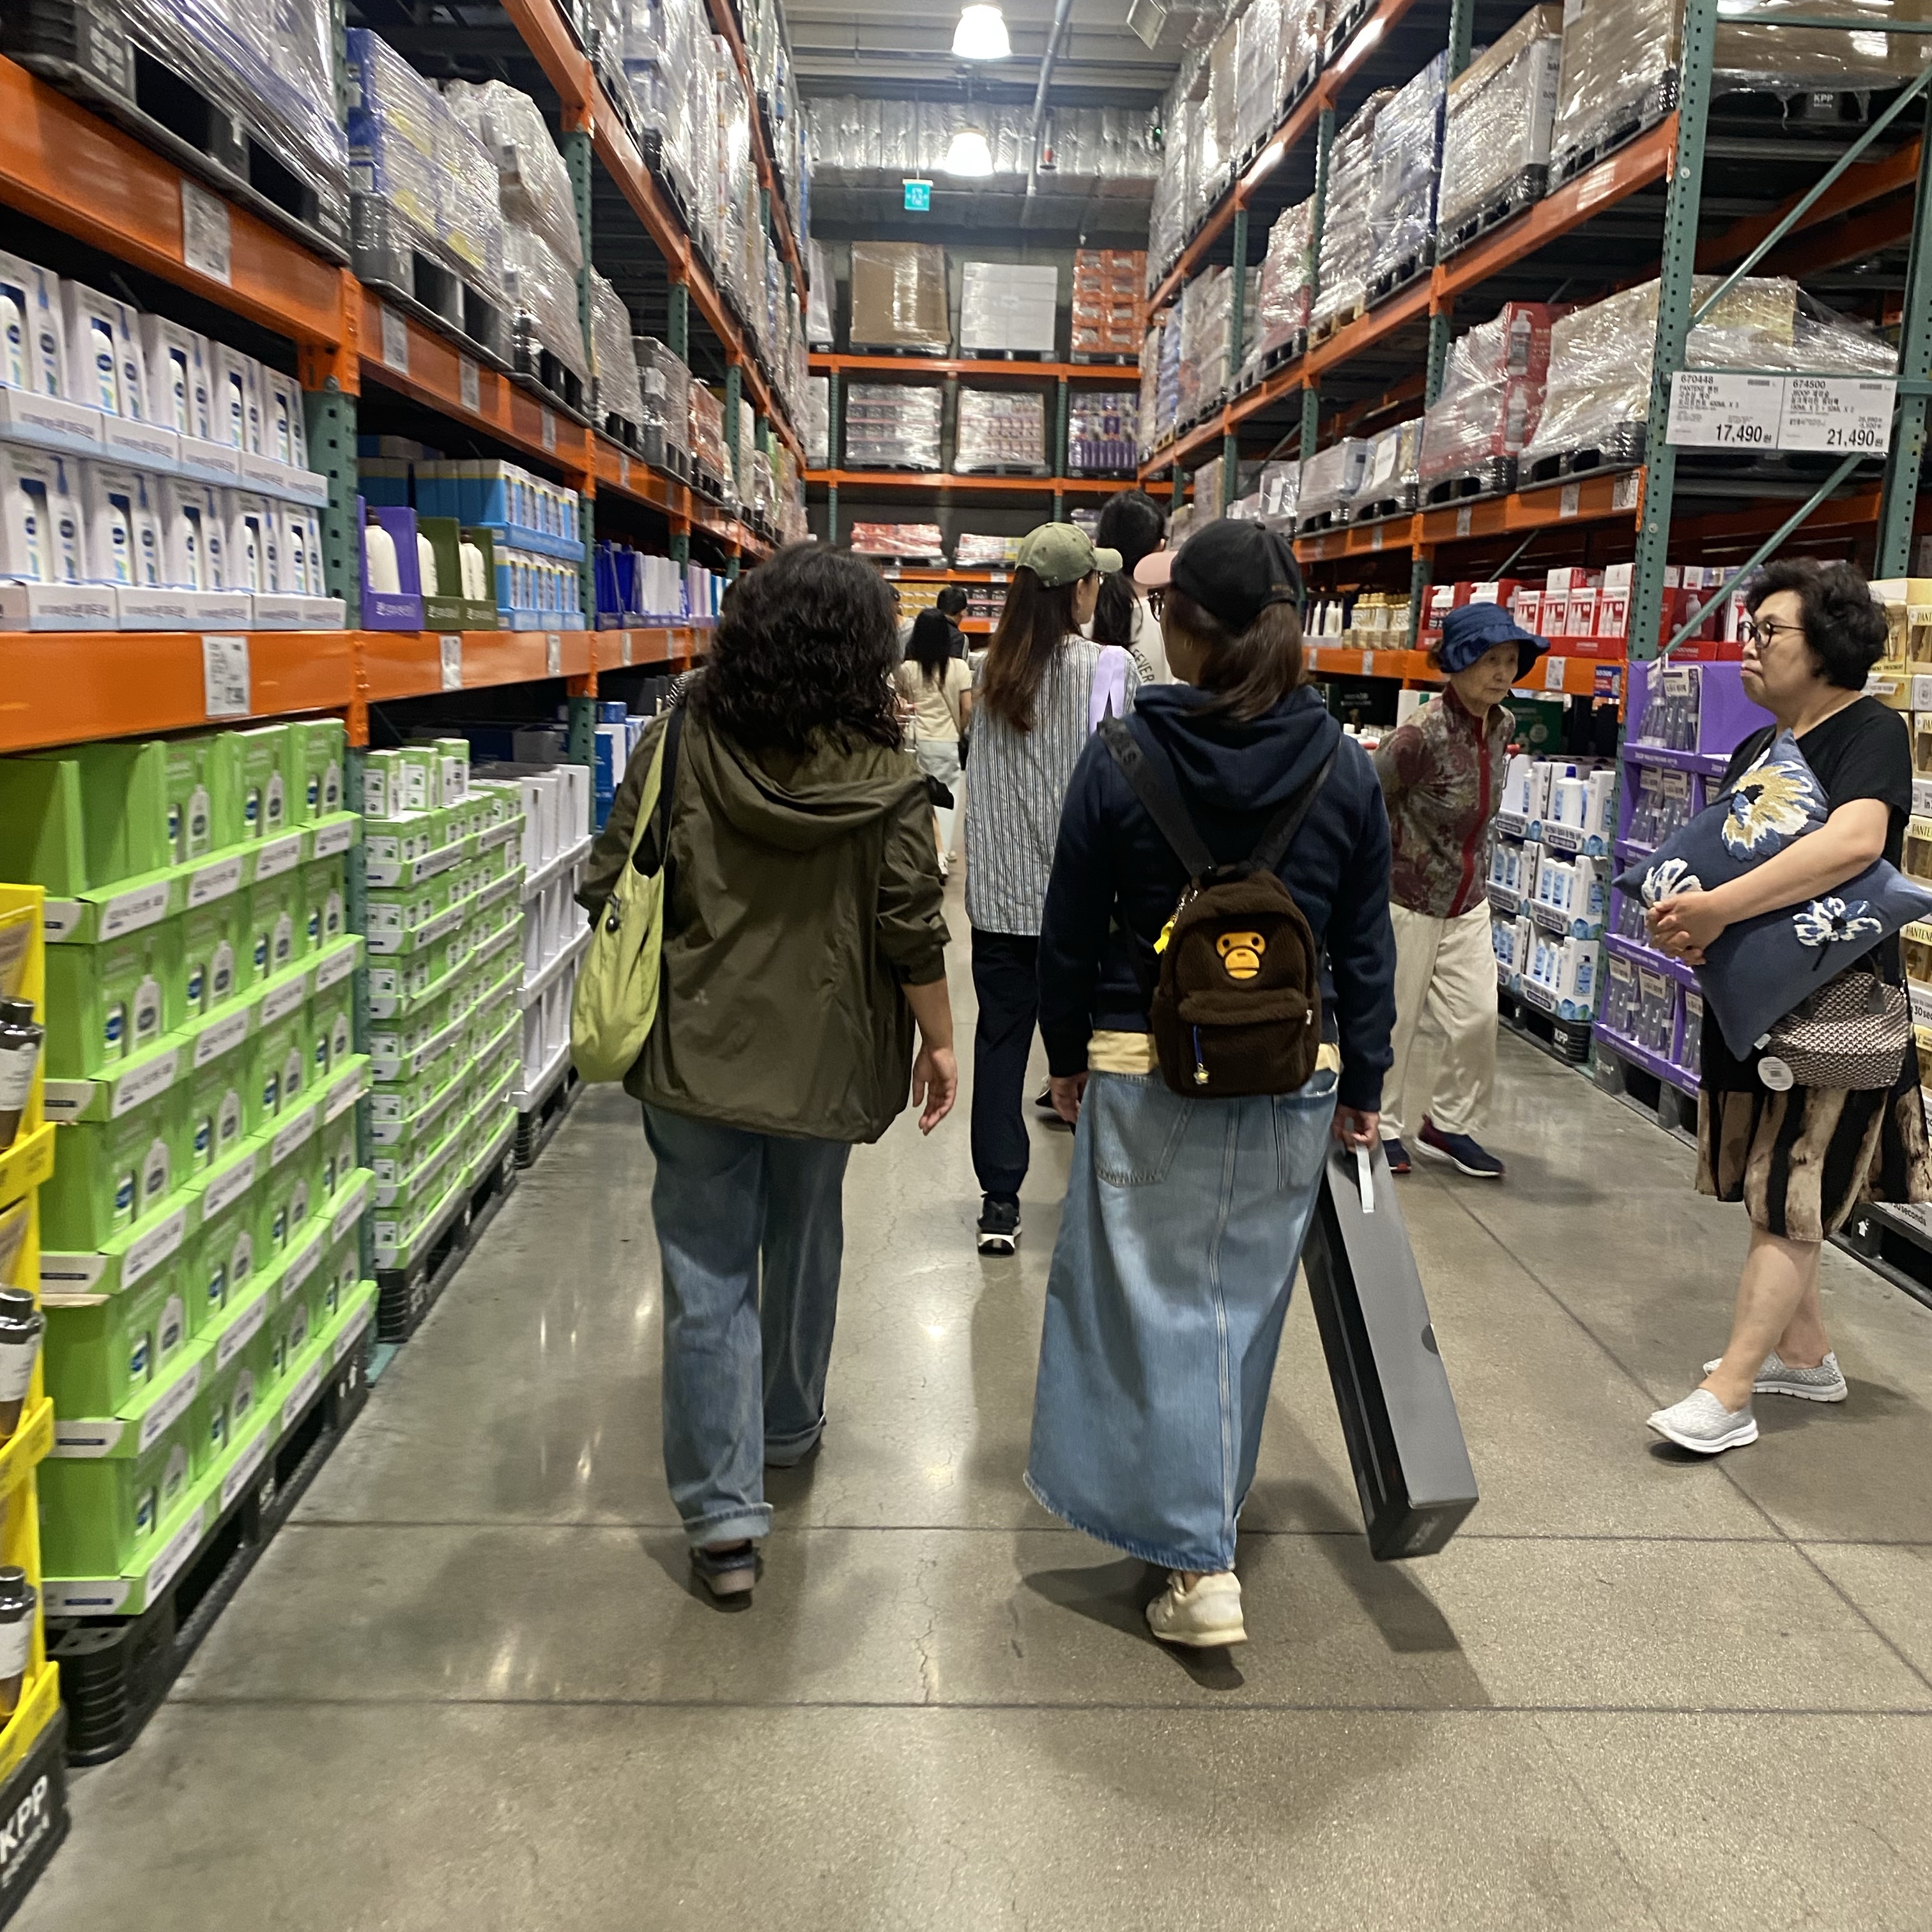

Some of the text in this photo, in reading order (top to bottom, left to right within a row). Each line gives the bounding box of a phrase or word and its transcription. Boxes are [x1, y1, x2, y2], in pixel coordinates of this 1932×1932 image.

[1814, 93, 1834, 103] KPP
[1681, 375, 1713, 384] 670448
[1793, 379, 1826, 389] 674500
[1716, 424, 1762, 443] 17,490
[1827, 427, 1874, 447] 21,490
[1914, 1005, 1922, 1016] 30
[1554, 1027, 1568, 1045] KPP
[1901, 1206, 1926, 1226] seconds
[0, 1775, 48, 1864] KPP
